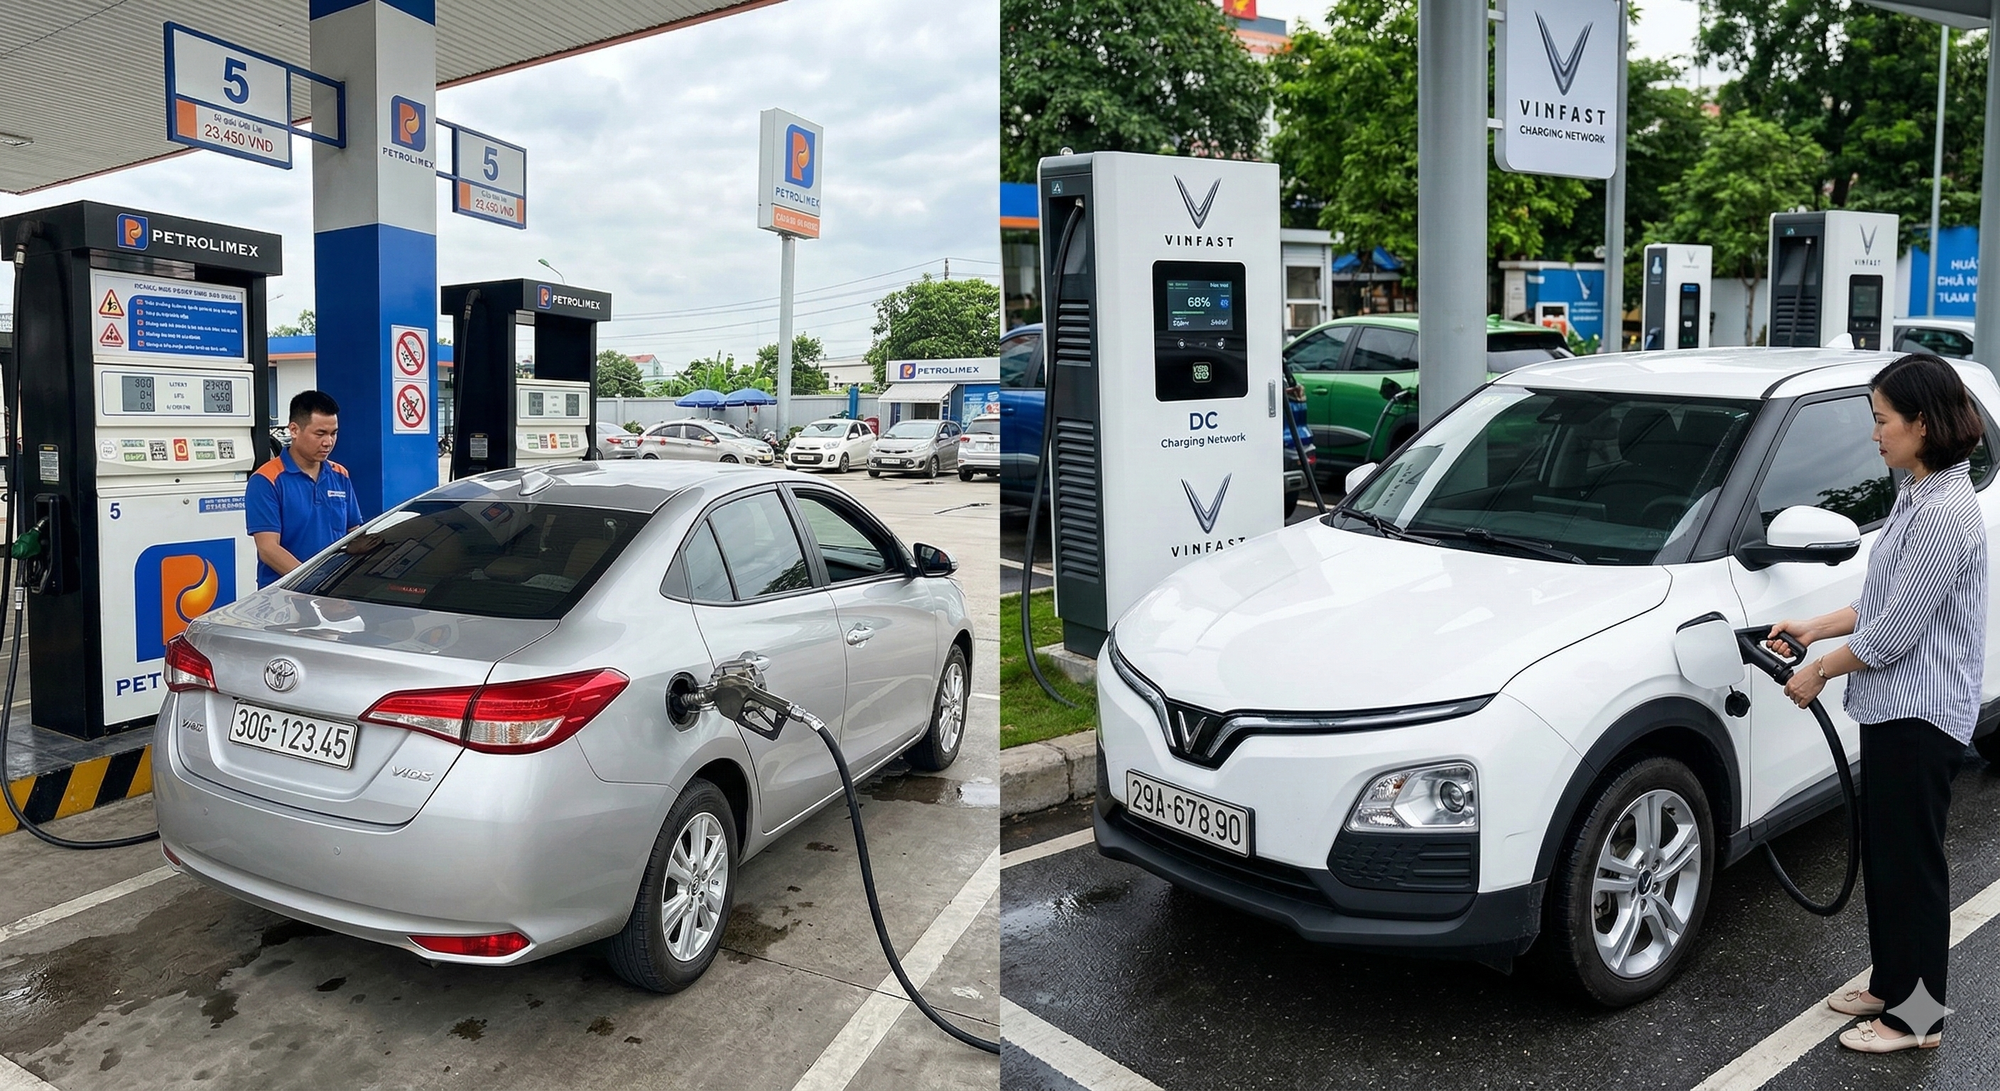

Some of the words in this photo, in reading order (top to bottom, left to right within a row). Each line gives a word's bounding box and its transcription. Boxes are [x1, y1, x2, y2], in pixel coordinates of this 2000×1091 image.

[223, 57, 249, 104] 5
[1520, 99, 1606, 126] VINFAST
[204, 124, 245, 146] 23,450
[247, 135, 274, 153] VND
[1520, 125, 1563, 139] CHARGING
[1565, 130, 1606, 144] NETWORK
[382, 147, 435, 170] PETROLIMEX
[483, 146, 499, 181] 5
[152, 229, 259, 257] PETROLIMEX
[1164, 235, 1234, 248] VINFAST
[552, 295, 601, 310] PETROLIMEX
[1187, 296, 1211, 308] 68%
[917, 366, 980, 375] PETROLIMEX
[1189, 411, 1218, 431] DC
[1161, 436, 1205, 449] Charging
[1207, 432, 1246, 445] Network
[110, 502, 121, 519] 5
[235, 708, 350, 760] 30G-123.45
[391, 765, 434, 782] VIOS
[1132, 779, 1241, 846] 29A-678.90
